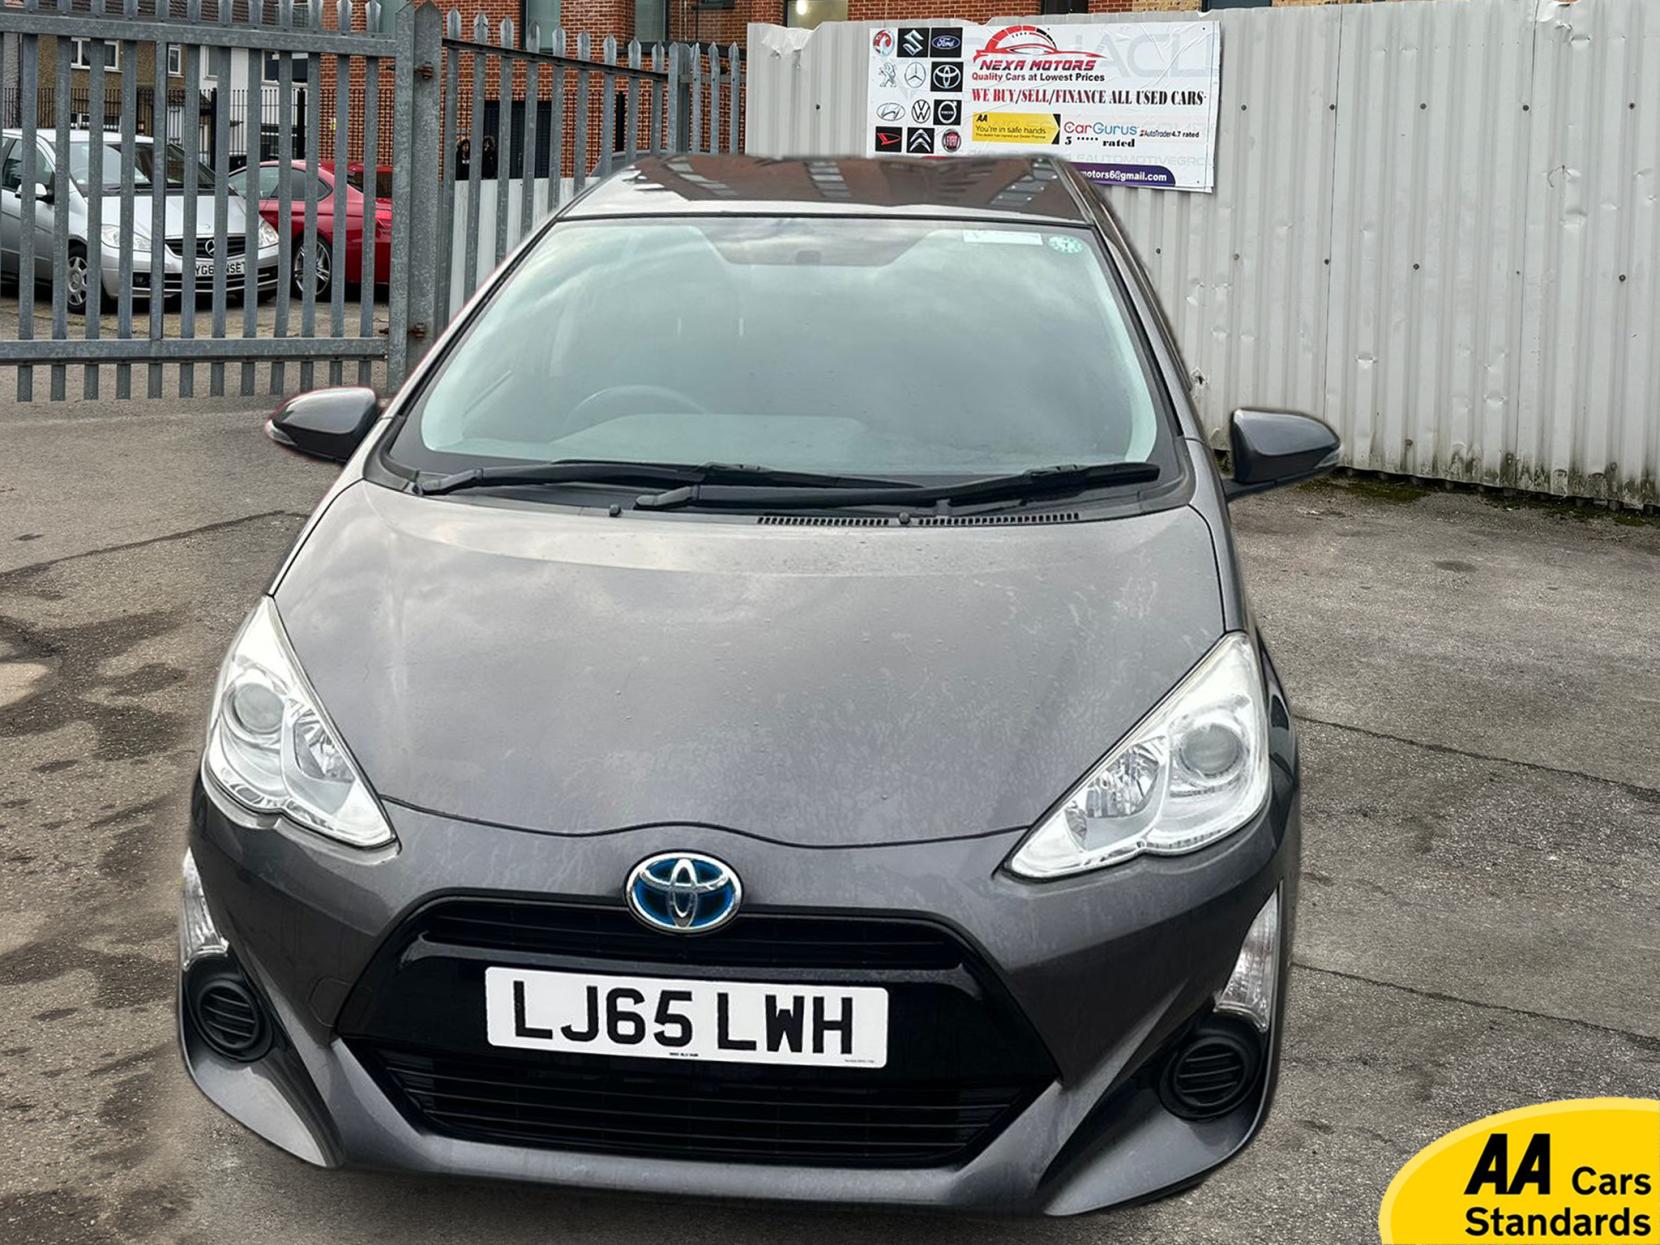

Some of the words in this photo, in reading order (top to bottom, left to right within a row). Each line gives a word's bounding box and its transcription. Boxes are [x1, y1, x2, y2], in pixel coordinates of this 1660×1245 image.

[980, 60, 1026, 71] NEXA
[1029, 60, 1096, 71] MOTORS
[972, 72, 1003, 82] Quality
[1005, 73, 1026, 81] Cars
[1028, 73, 1037, 81] at
[1040, 73, 1073, 81] Lowest
[1075, 73, 1105, 82] Prices
[972, 88, 990, 102] WE
[1109, 90, 1132, 104] ALL
[1136, 90, 1168, 105] USED
[1171, 90, 1204, 105] CARS
[976, 114, 988, 122] AA
[976, 125, 998, 133] You're
[1063, 121, 1138, 135] CarGurus
[1103, 138, 1135, 148] rated
[513, 980, 693, 1048] LJ65
[717, 992, 853, 1055] LWH
